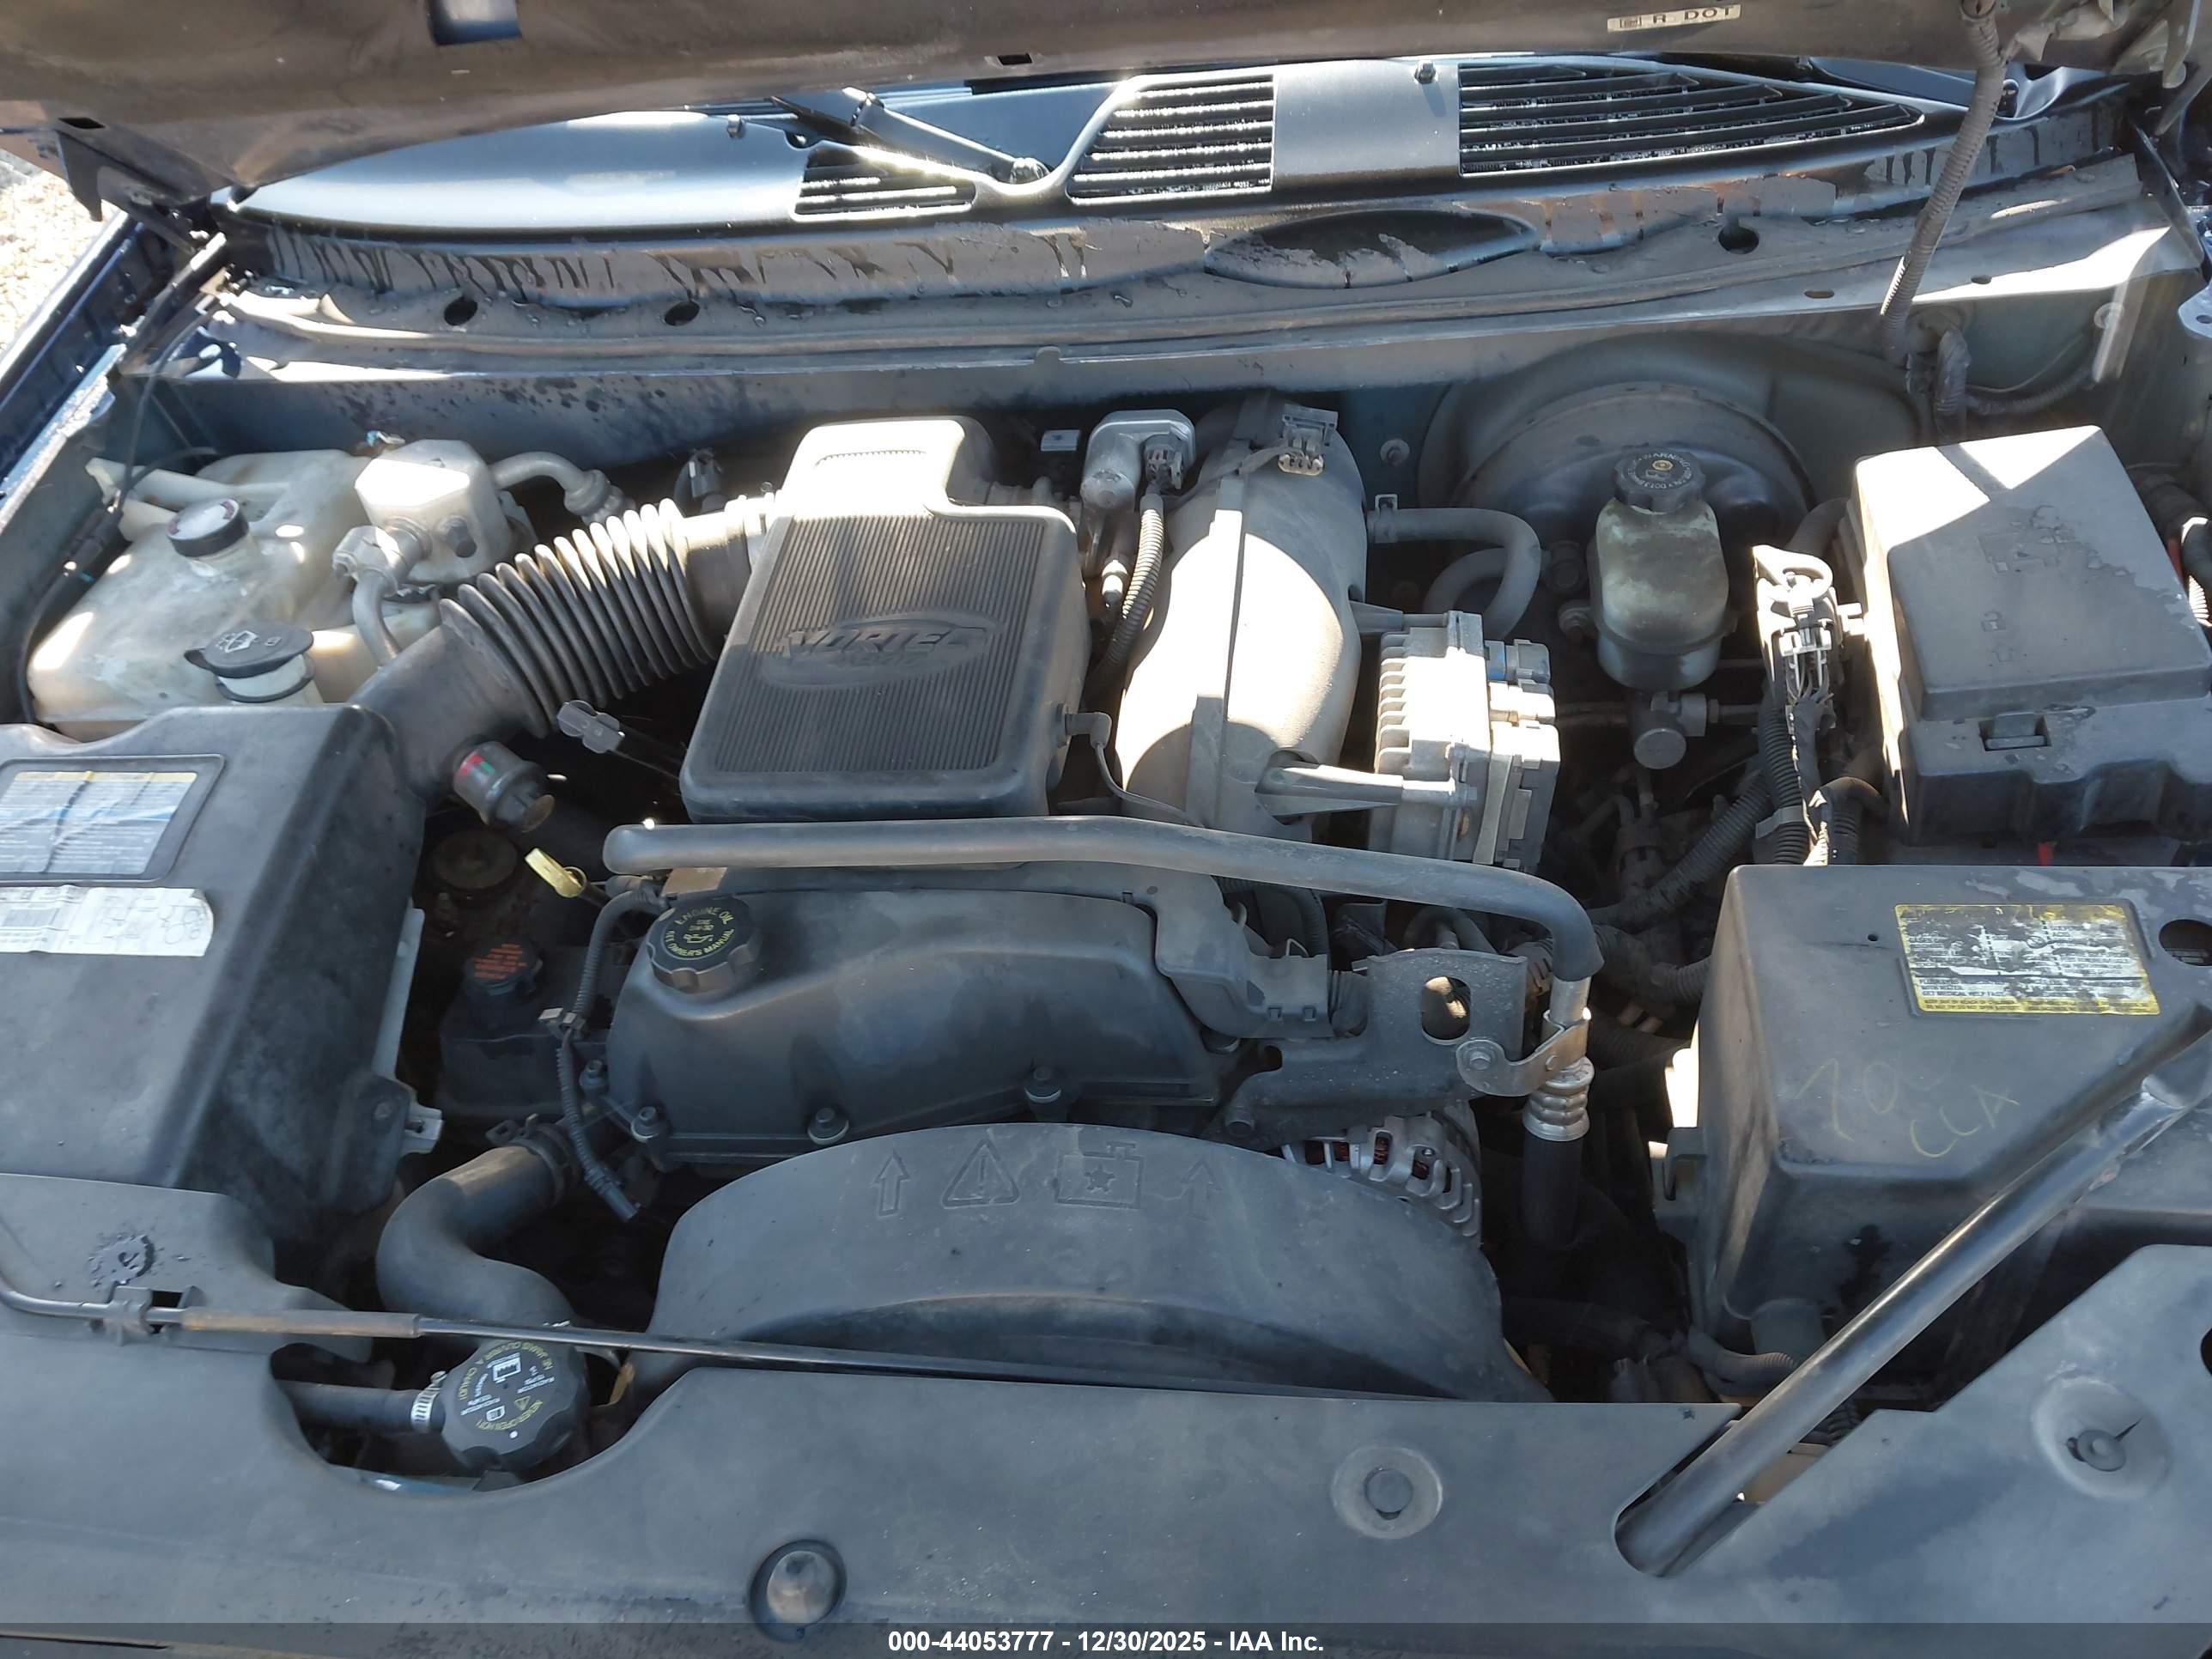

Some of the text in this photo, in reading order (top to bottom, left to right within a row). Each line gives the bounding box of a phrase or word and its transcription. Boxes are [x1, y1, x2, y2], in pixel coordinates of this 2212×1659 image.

[1685, 6, 1734, 20] DOT
[674, 907, 734, 925] ENGINE OIL
[703, 928, 735, 953] MANUAL
